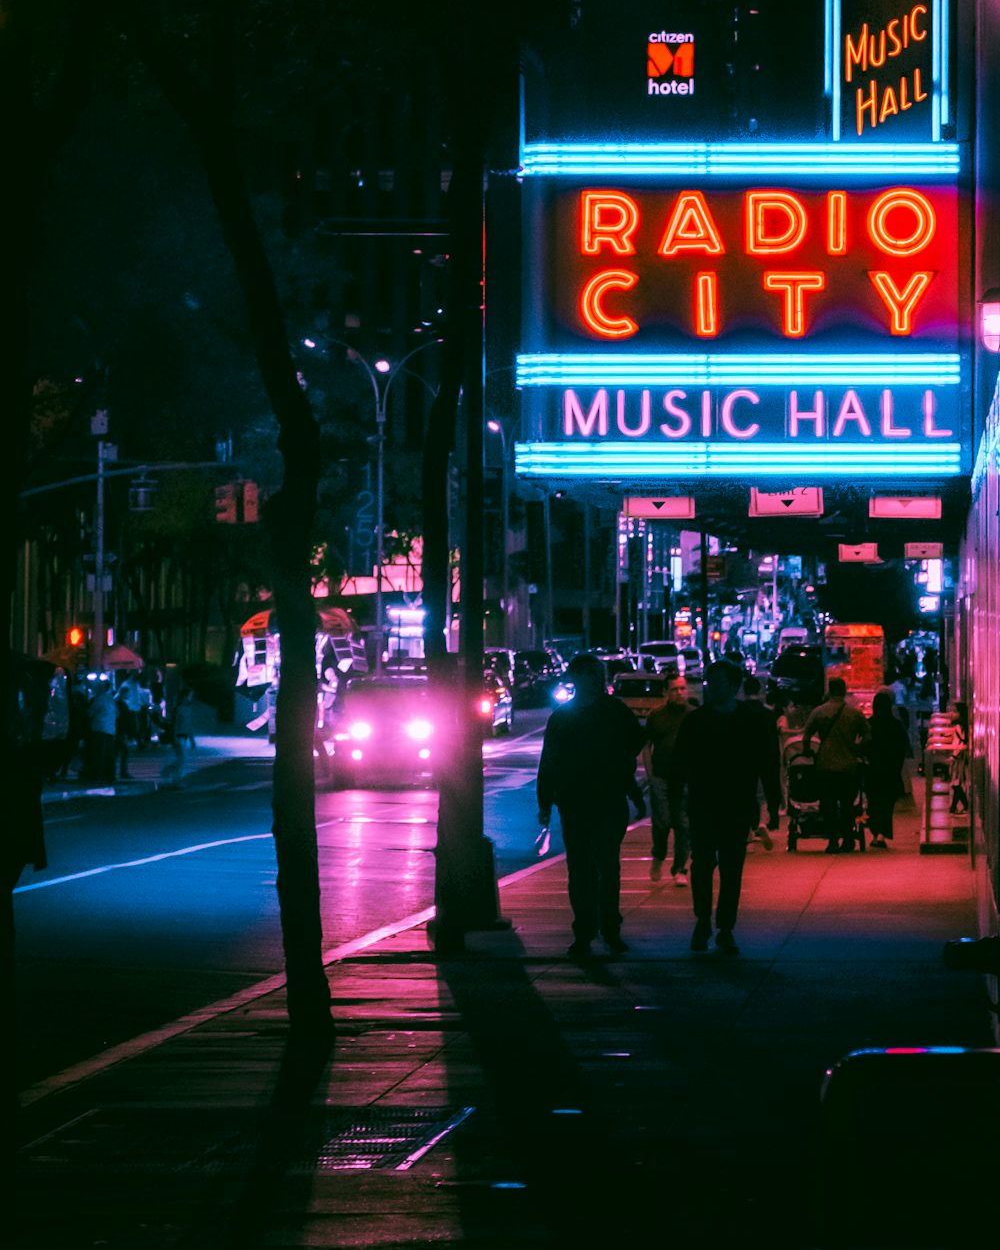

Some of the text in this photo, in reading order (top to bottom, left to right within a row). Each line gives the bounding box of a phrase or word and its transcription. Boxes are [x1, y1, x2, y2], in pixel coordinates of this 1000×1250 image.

[648, 31, 694, 43] citizen
[648, 78, 694, 95] hotel
[580, 187, 937, 257] RADIO
[579, 269, 938, 338] CITY
[563, 388, 954, 438] MUSIC HALL
[356, 461, 375, 576] 1251
